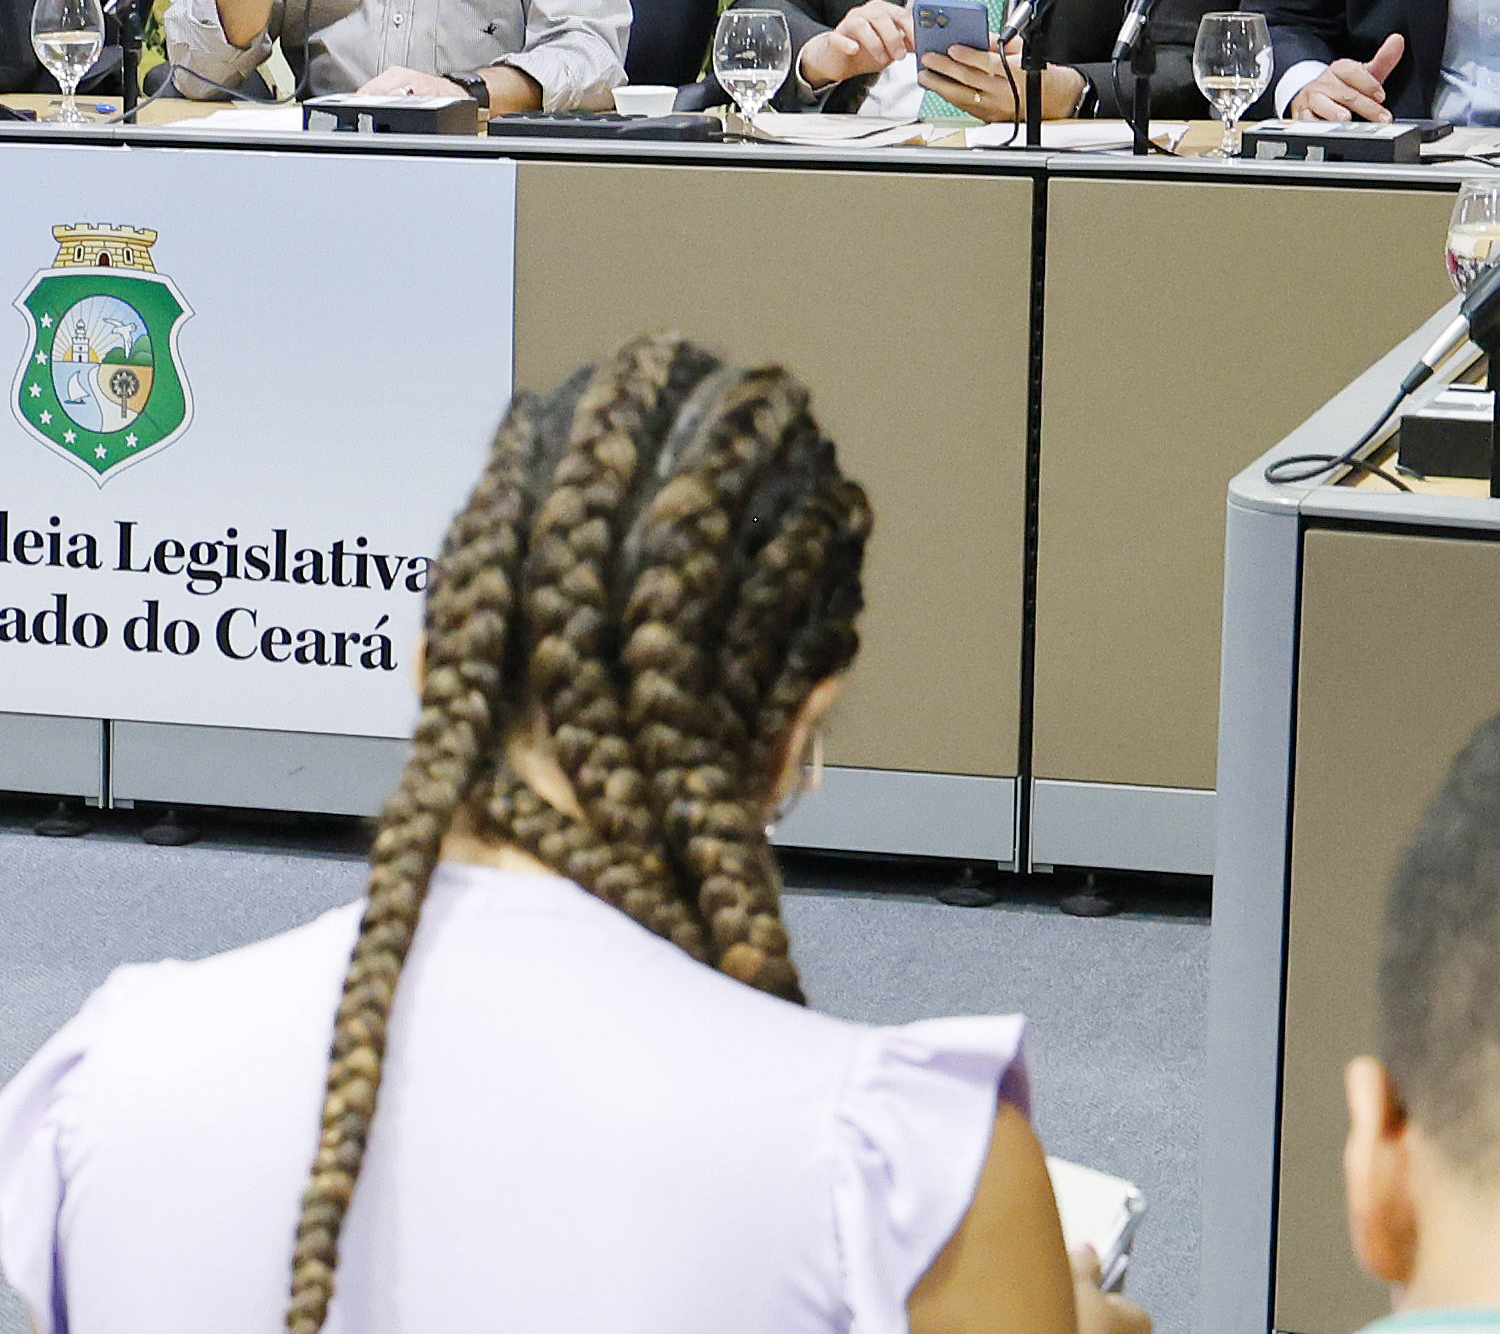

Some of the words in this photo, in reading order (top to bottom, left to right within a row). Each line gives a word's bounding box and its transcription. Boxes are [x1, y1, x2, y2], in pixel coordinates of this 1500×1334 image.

[112, 520, 434, 595] Legislativa
[123, 600, 200, 655] do
[215, 607, 398, 671] Ceará
